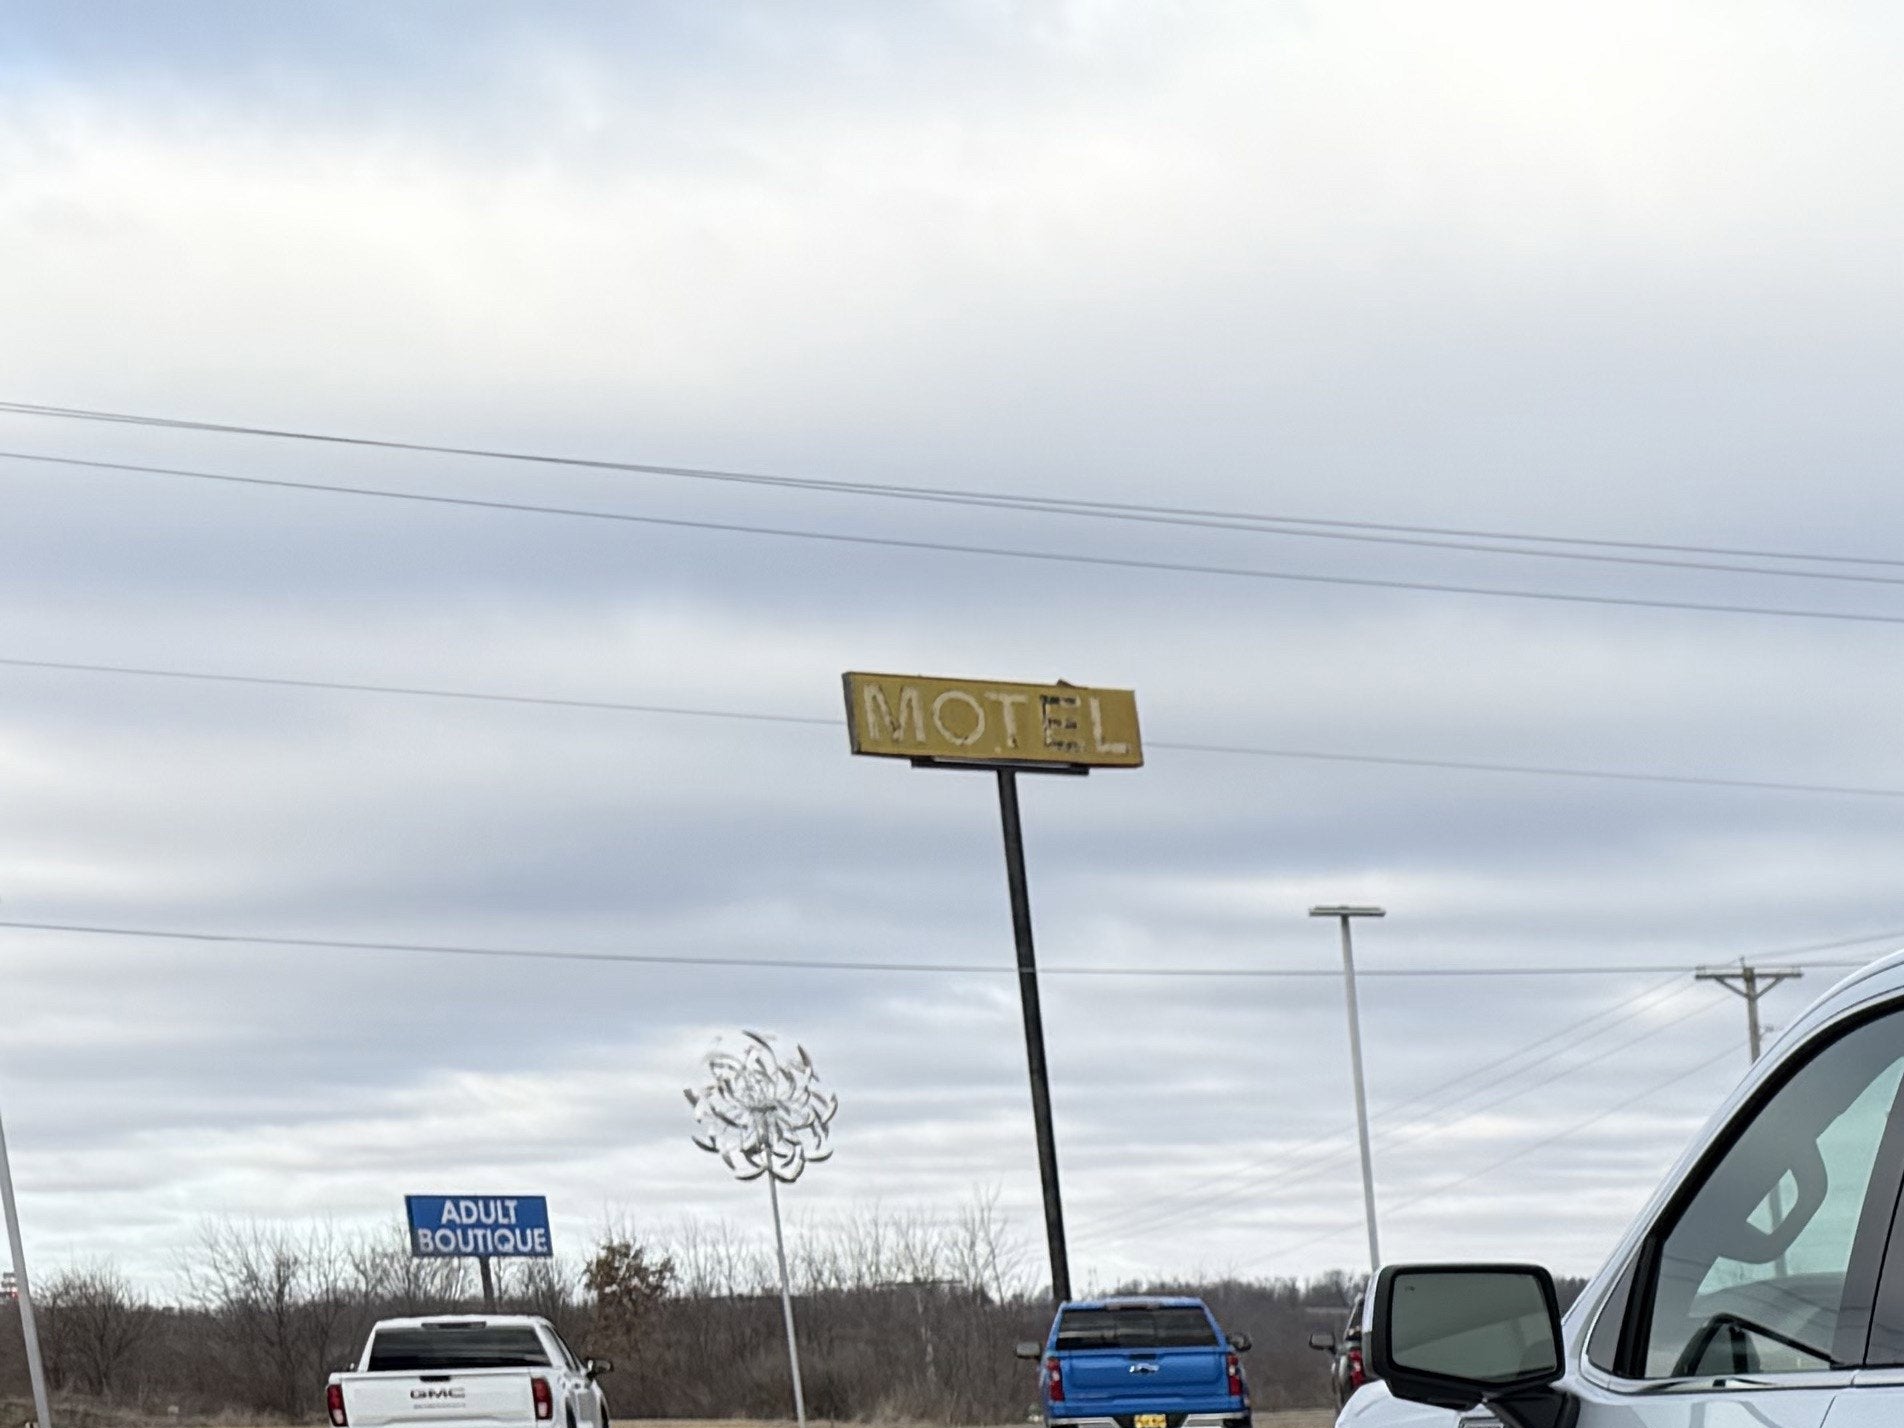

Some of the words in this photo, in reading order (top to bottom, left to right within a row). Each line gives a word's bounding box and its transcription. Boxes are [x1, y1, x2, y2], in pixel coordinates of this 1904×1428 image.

[862, 682, 1129, 754] MOTEL
[441, 1199, 518, 1225] ADULT
[417, 1227, 548, 1253] BOUTIQUE
